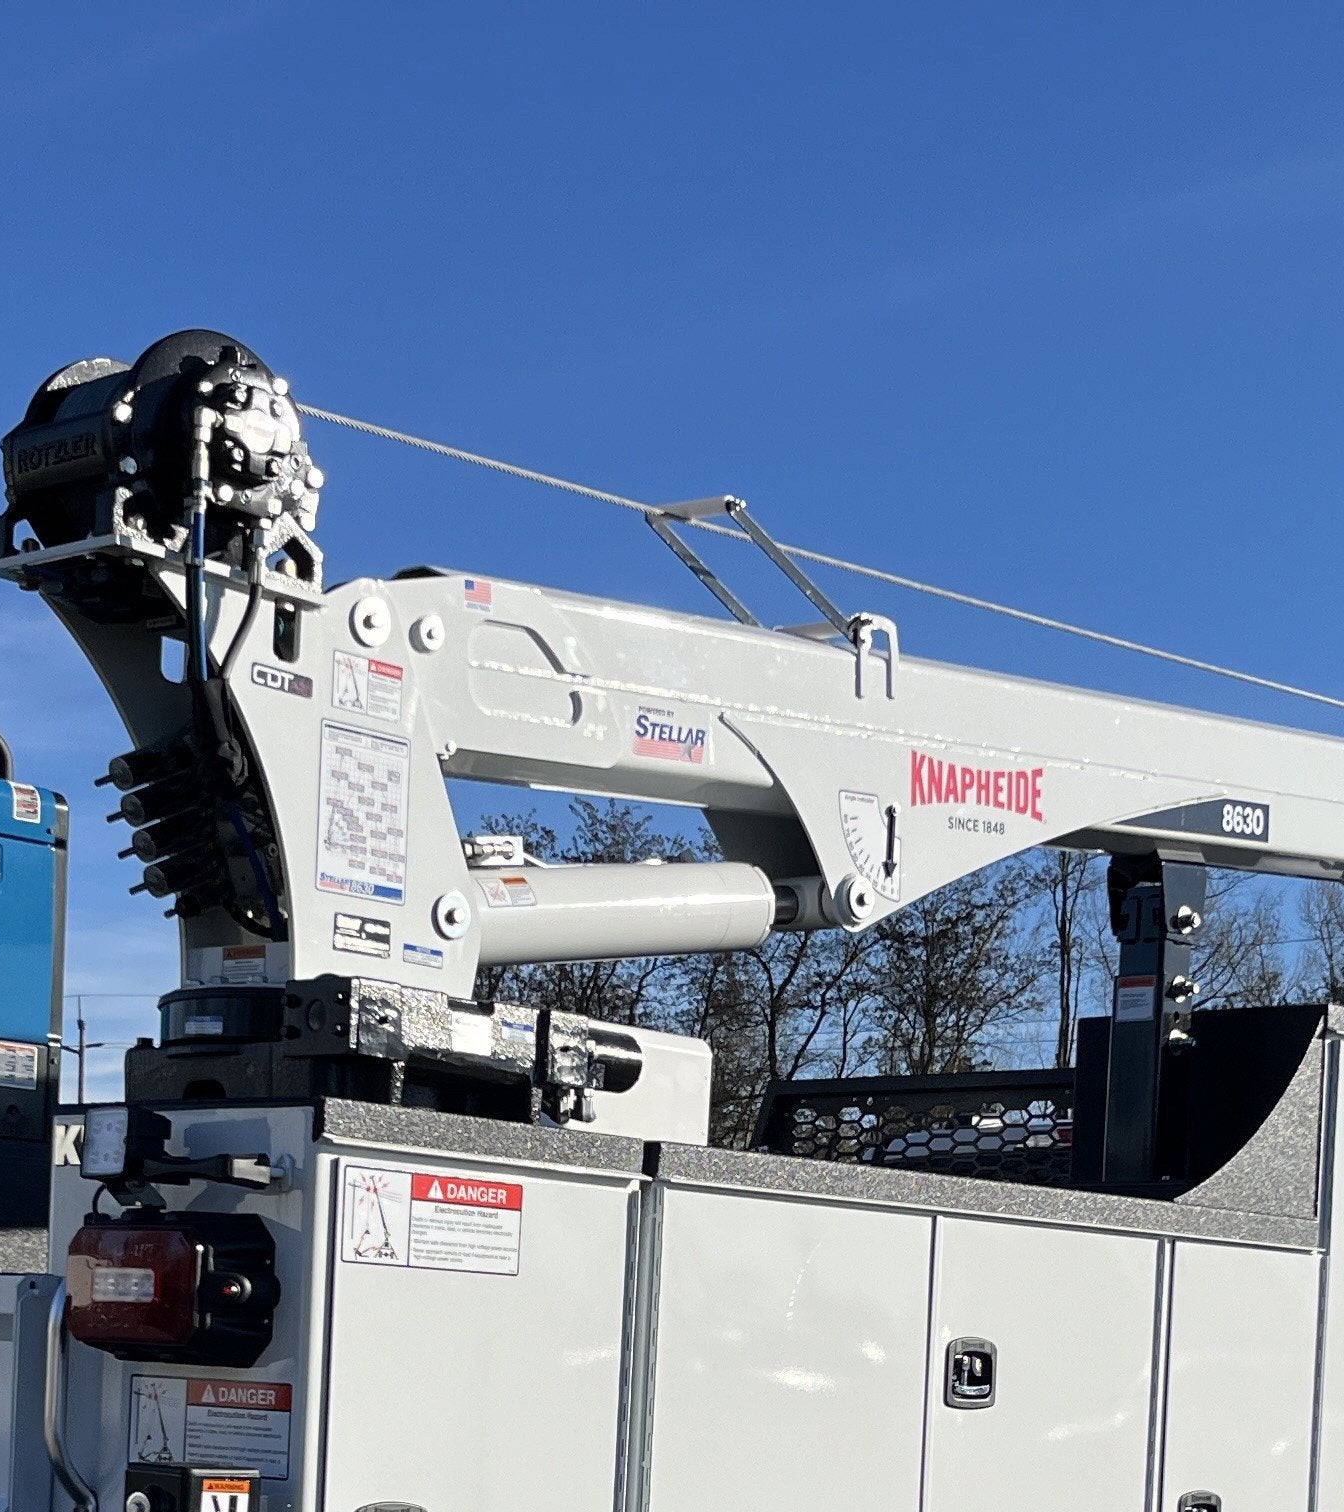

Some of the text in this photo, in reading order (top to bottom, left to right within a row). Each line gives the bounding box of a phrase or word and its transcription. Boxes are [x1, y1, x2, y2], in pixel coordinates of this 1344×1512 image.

[253, 662, 295, 692] CDT
[635, 714, 706, 747] STELLAR
[910, 749, 1043, 822] KNAPHEIDE
[947, 816, 1005, 835] SINCE 1848
[1222, 803, 1264, 836] 8630
[446, 1183, 507, 1205] DANGER
[218, 1387, 276, 1406] DANGER
